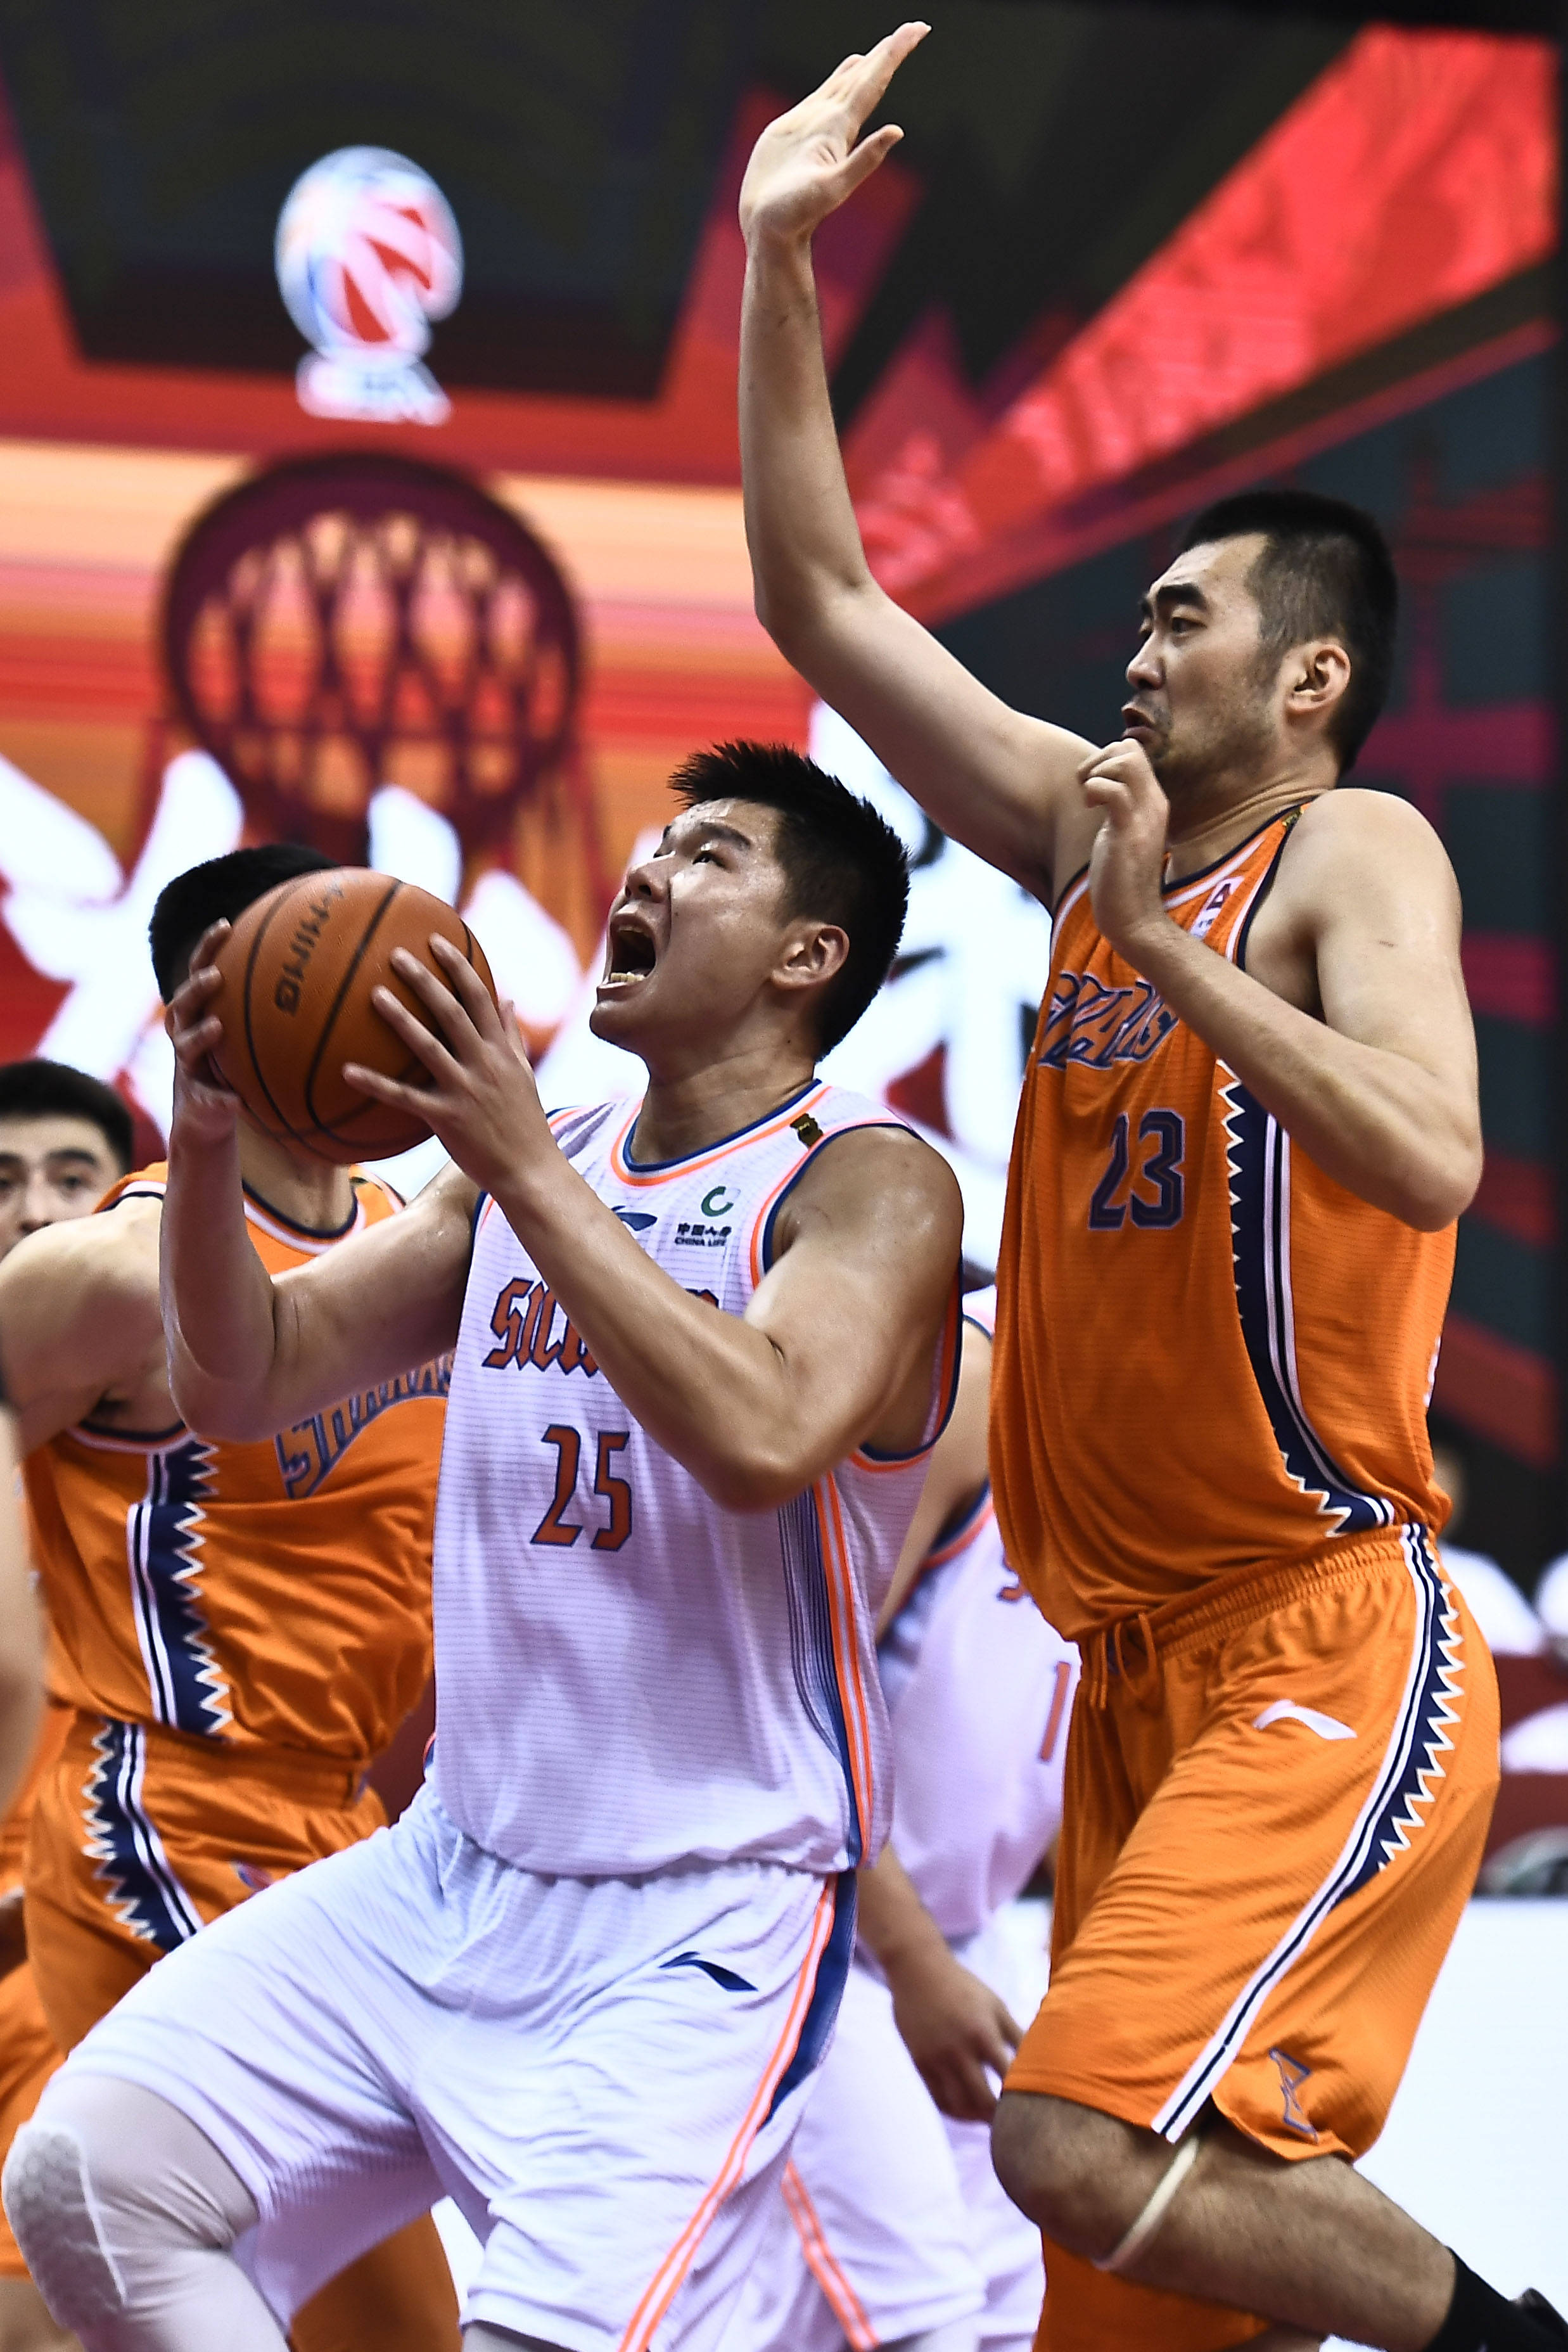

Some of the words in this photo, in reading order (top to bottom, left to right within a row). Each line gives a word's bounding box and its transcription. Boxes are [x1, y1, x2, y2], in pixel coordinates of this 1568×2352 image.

[1088, 1108, 1185, 1230] 23
[674, 1237, 705, 1246] CHINA
[530, 1424, 632, 1551] 25
